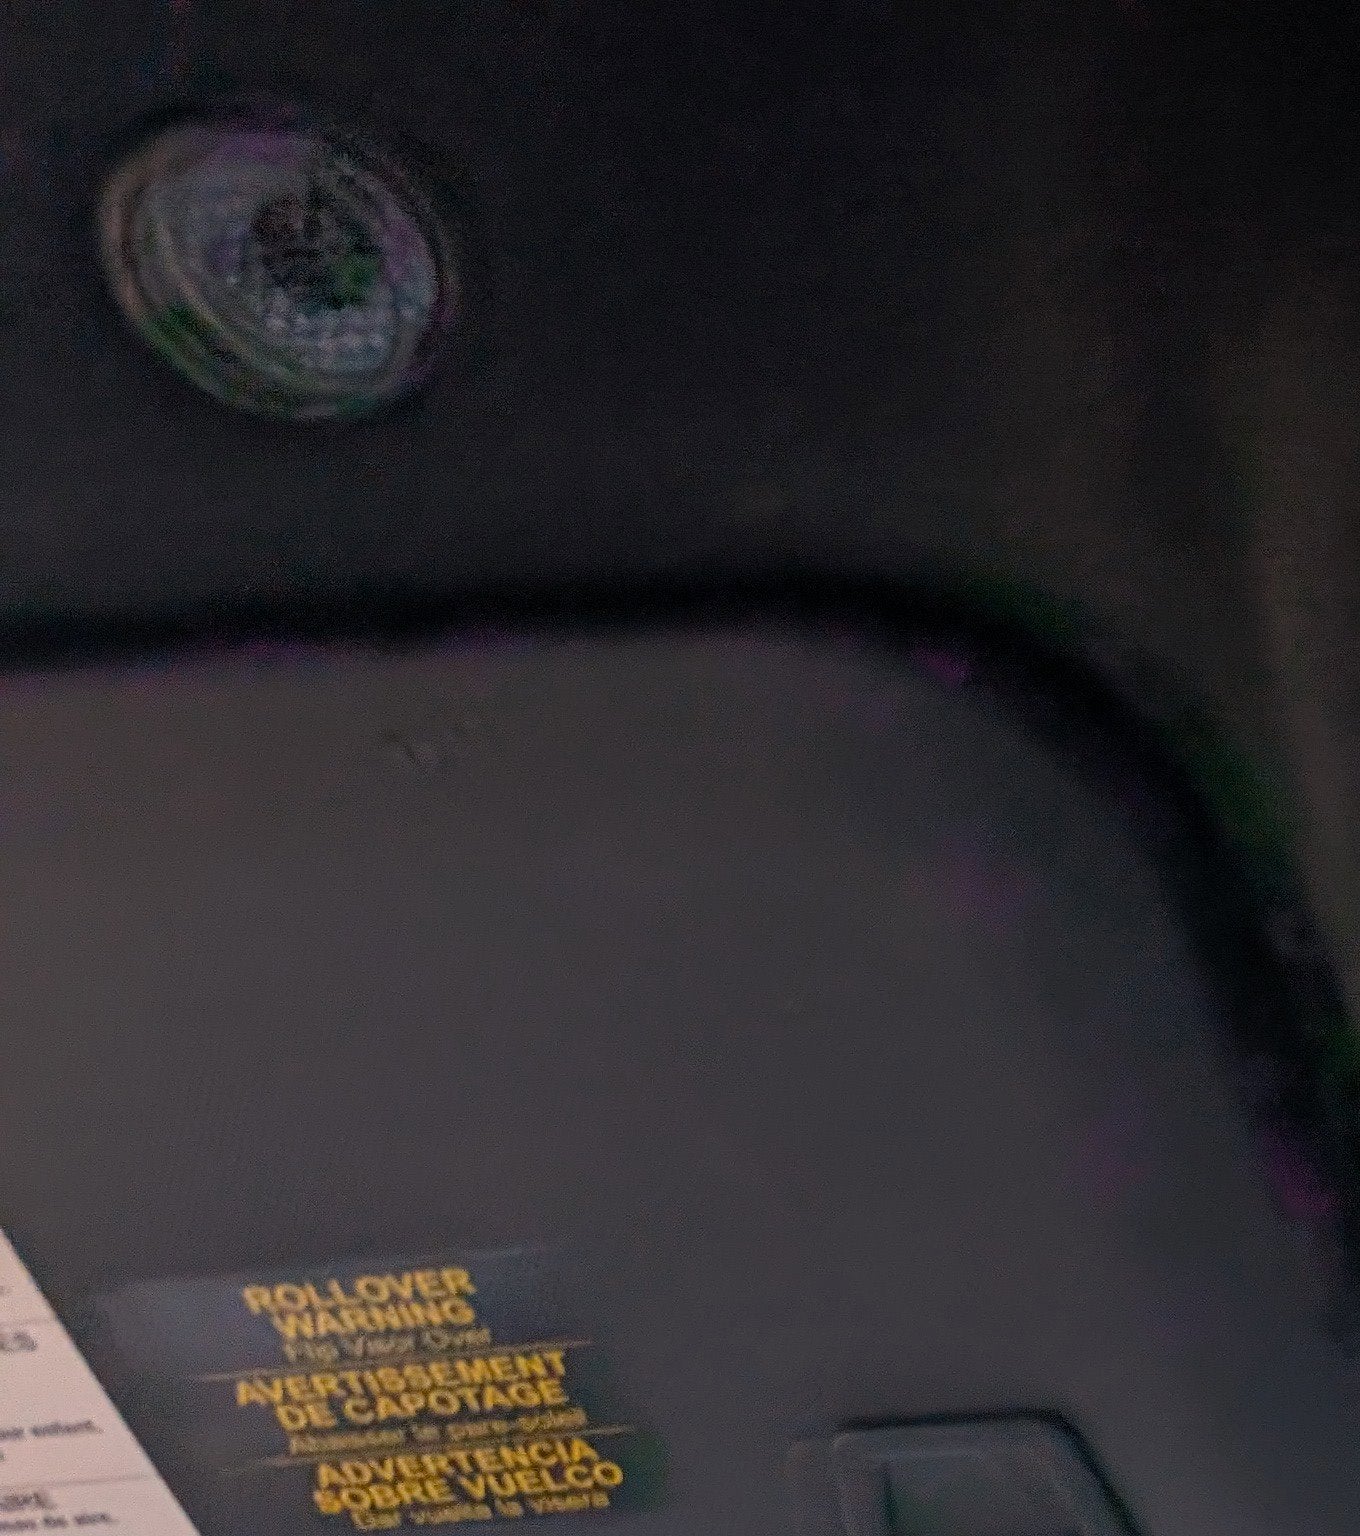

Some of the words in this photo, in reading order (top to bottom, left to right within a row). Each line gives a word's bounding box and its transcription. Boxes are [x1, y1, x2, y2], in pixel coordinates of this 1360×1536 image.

[243, 1267, 476, 1316] ROLLOVER
[273, 1298, 475, 1339] WARNING
[236, 1350, 565, 1406] AVERTISSEMENT
[276, 1402, 336, 1432] DE
[343, 1376, 569, 1425] CAPOTAGE
[313, 1477, 452, 1515] SOBRE
[456, 1461, 624, 1501] VUELCO
[318, 1438, 599, 1488] ADVERTENCIA
